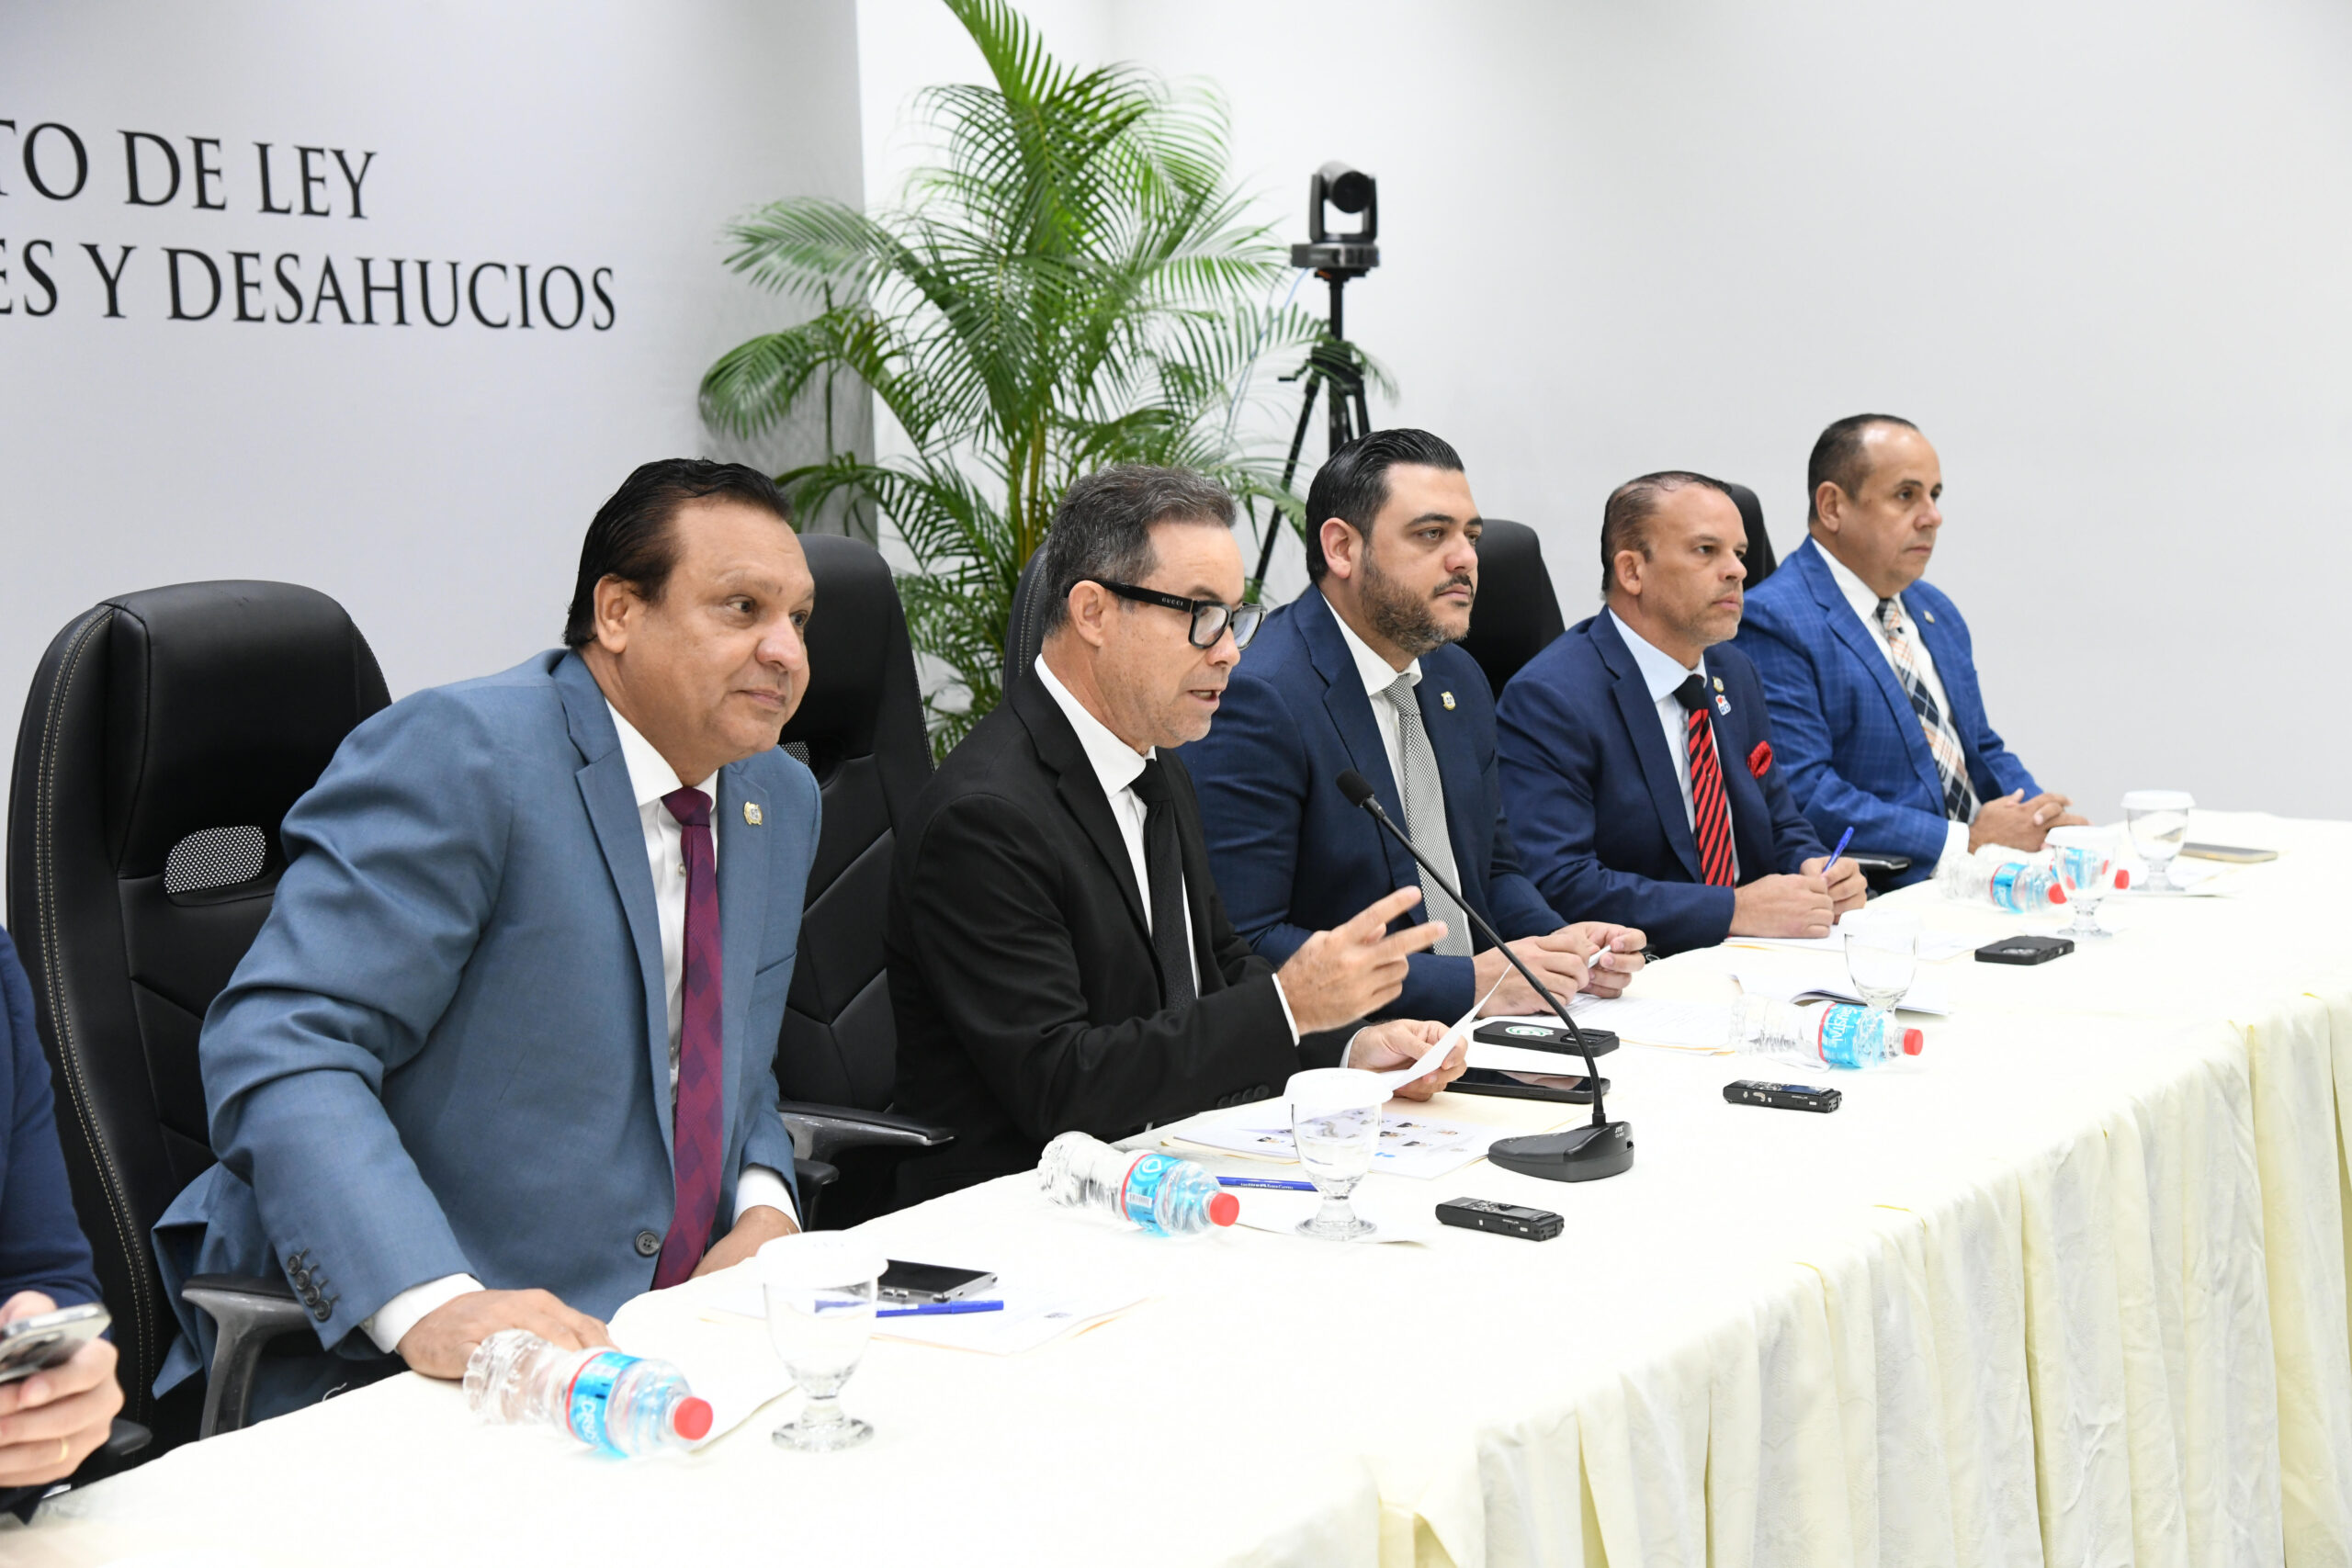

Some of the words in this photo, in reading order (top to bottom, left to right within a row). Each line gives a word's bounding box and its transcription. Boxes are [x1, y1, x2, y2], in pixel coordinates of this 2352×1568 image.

[0, 119, 88, 201] O
[117, 130, 227, 211] DE
[252, 141, 377, 220] LEY
[79, 243, 137, 319] Y
[161, 246, 616, 332] DESAHUCIOS
[1161, 597, 1183, 607] GUCCI
